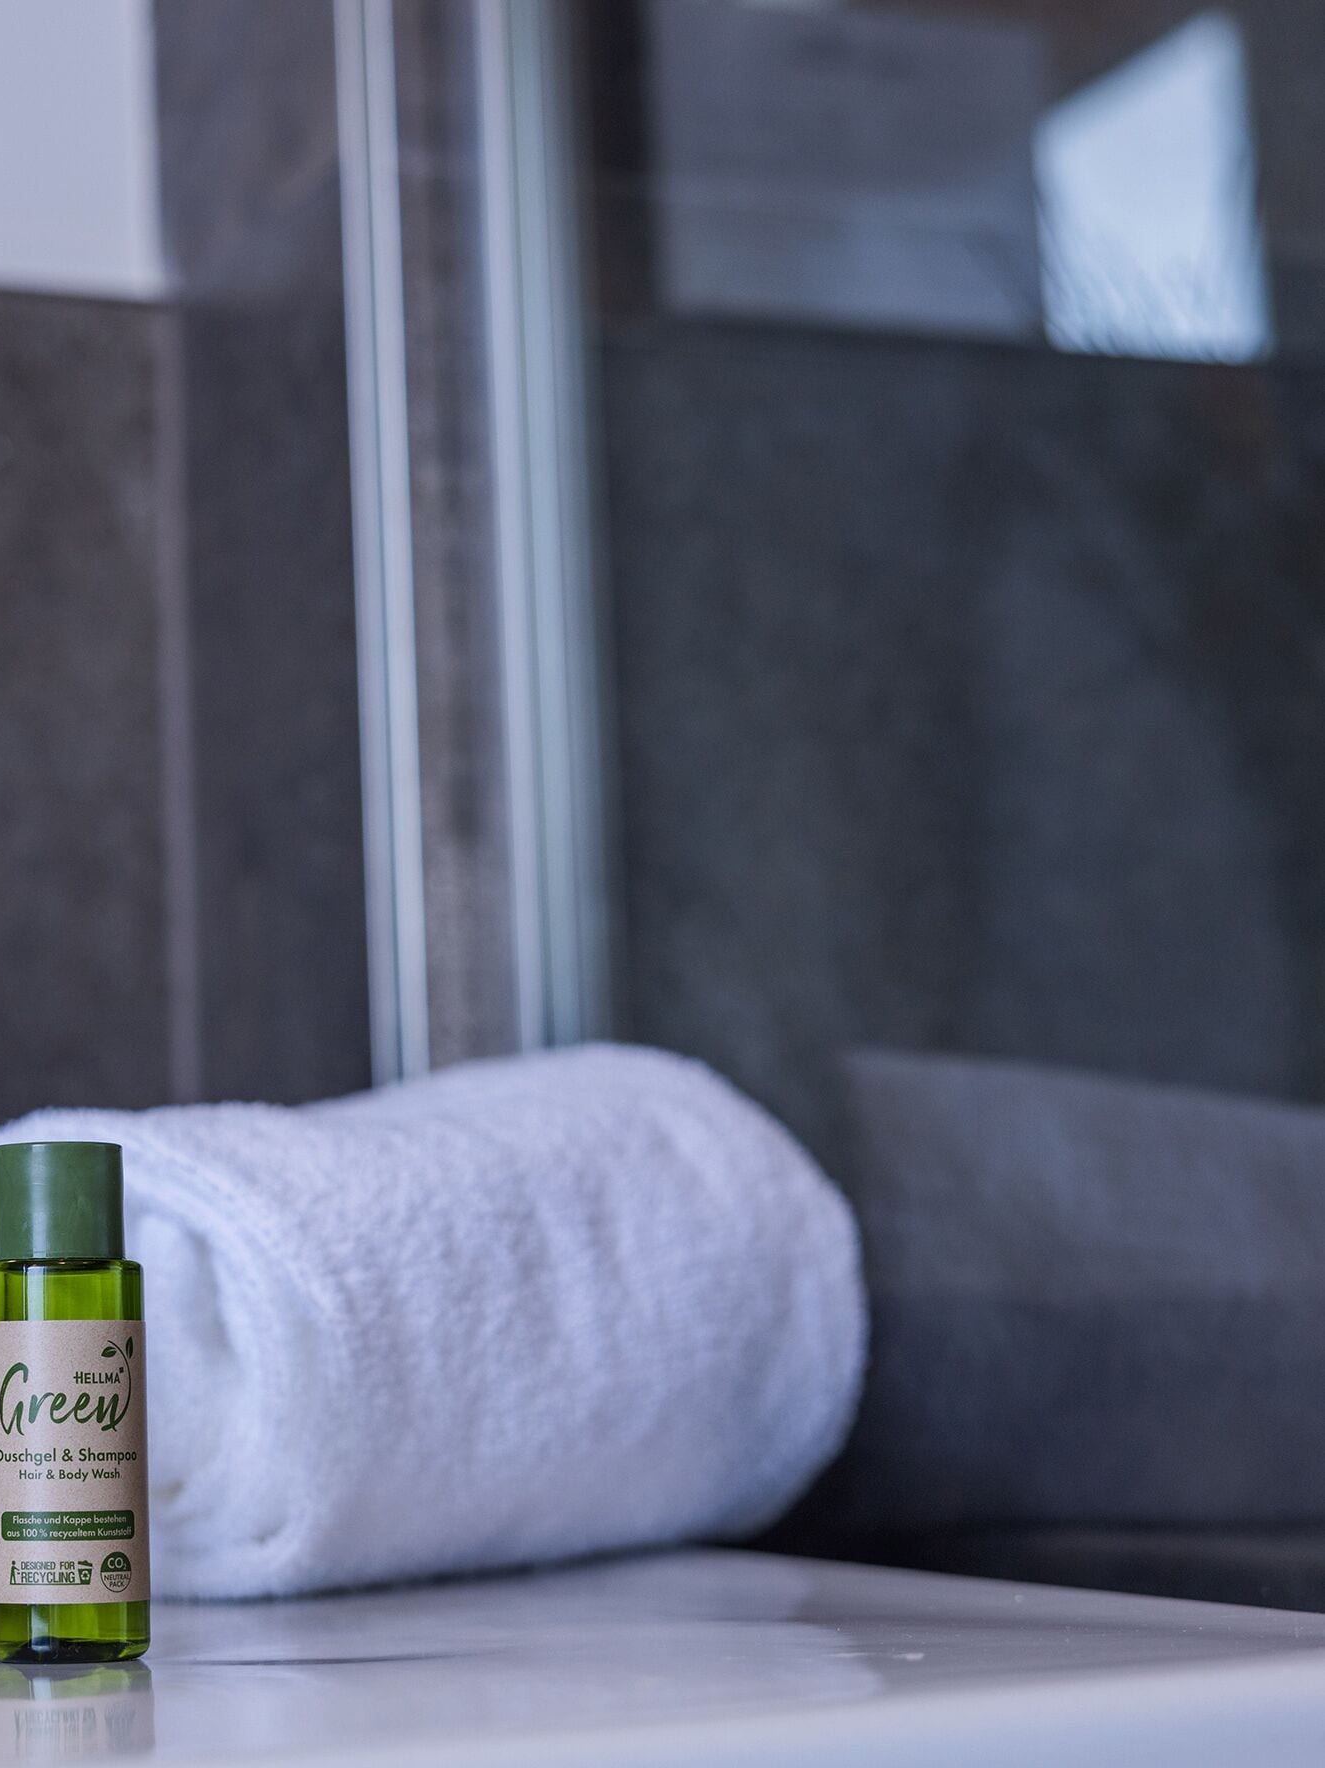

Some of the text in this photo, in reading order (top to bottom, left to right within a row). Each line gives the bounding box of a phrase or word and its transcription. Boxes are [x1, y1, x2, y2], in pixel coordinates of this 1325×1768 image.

[73, 1371, 121, 1384] HELLMA
[0, 1362, 130, 1436] Green
[61, 1449, 73, 1463] &
[78, 1448, 137, 1465] Shampoo
[19, 1468, 121, 1482] Hair & Body Wash
[12, 1514, 127, 1526] Flasche und Kappe bestehen
[6, 1526, 132, 1539] aus 100 % recyceltem Kunststoff
[20, 1560, 75, 1570] DESIGNED FOR
[20, 1571, 75, 1584] RECYCLING
[103, 1572, 130, 1582] NEUTRAL
[109, 1580, 125, 1588] PACK
